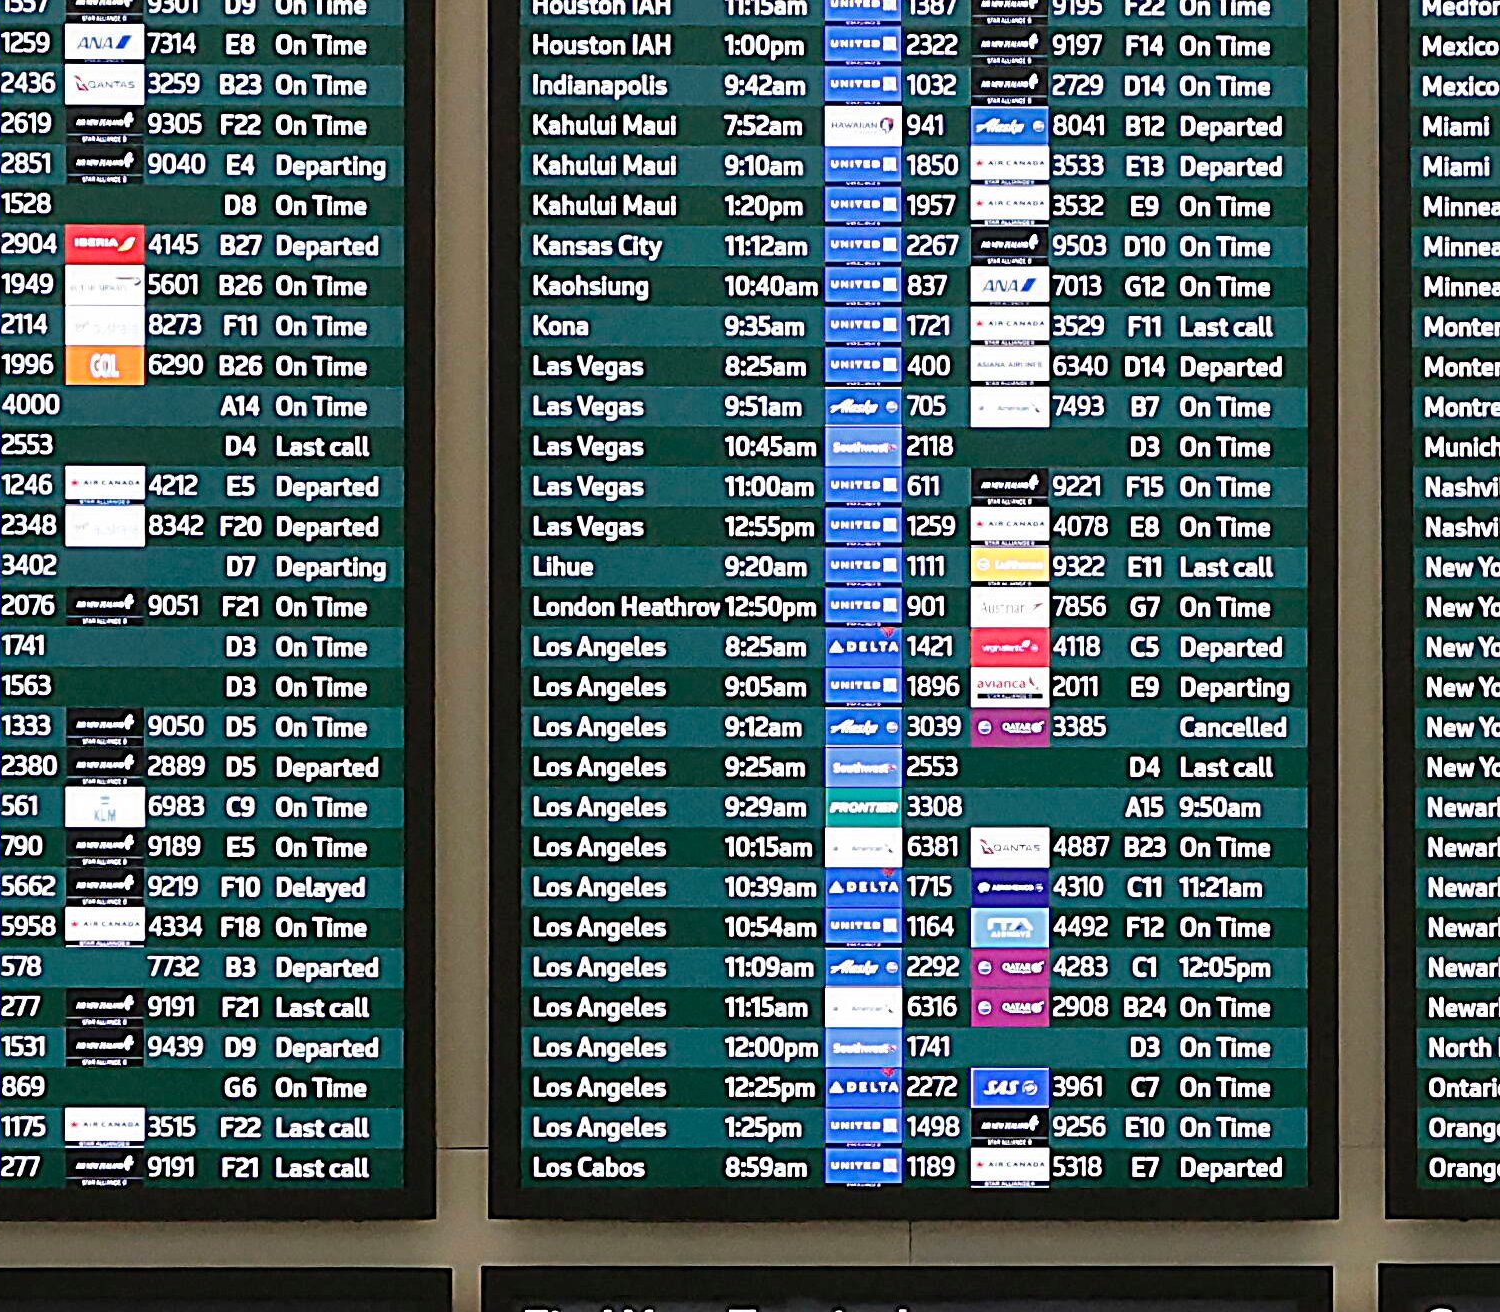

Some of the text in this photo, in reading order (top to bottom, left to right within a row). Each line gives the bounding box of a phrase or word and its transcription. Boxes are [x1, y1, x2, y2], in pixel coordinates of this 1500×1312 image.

[532, 113, 617, 136] Kahului
[622, 113, 677, 136] Maui
[723, 114, 803, 136] 7:52am
[906, 113, 944, 136] 941
[976, 119, 1025, 134] Alaska
[1052, 113, 1105, 136] 8041
[1125, 115, 1165, 137] B12
[1180, 115, 1283, 142] Departed
[0, 151, 51, 174] 2851
[147, 152, 206, 175] 9040
[226, 153, 255, 176] E4
[276, 153, 387, 182] Departing
